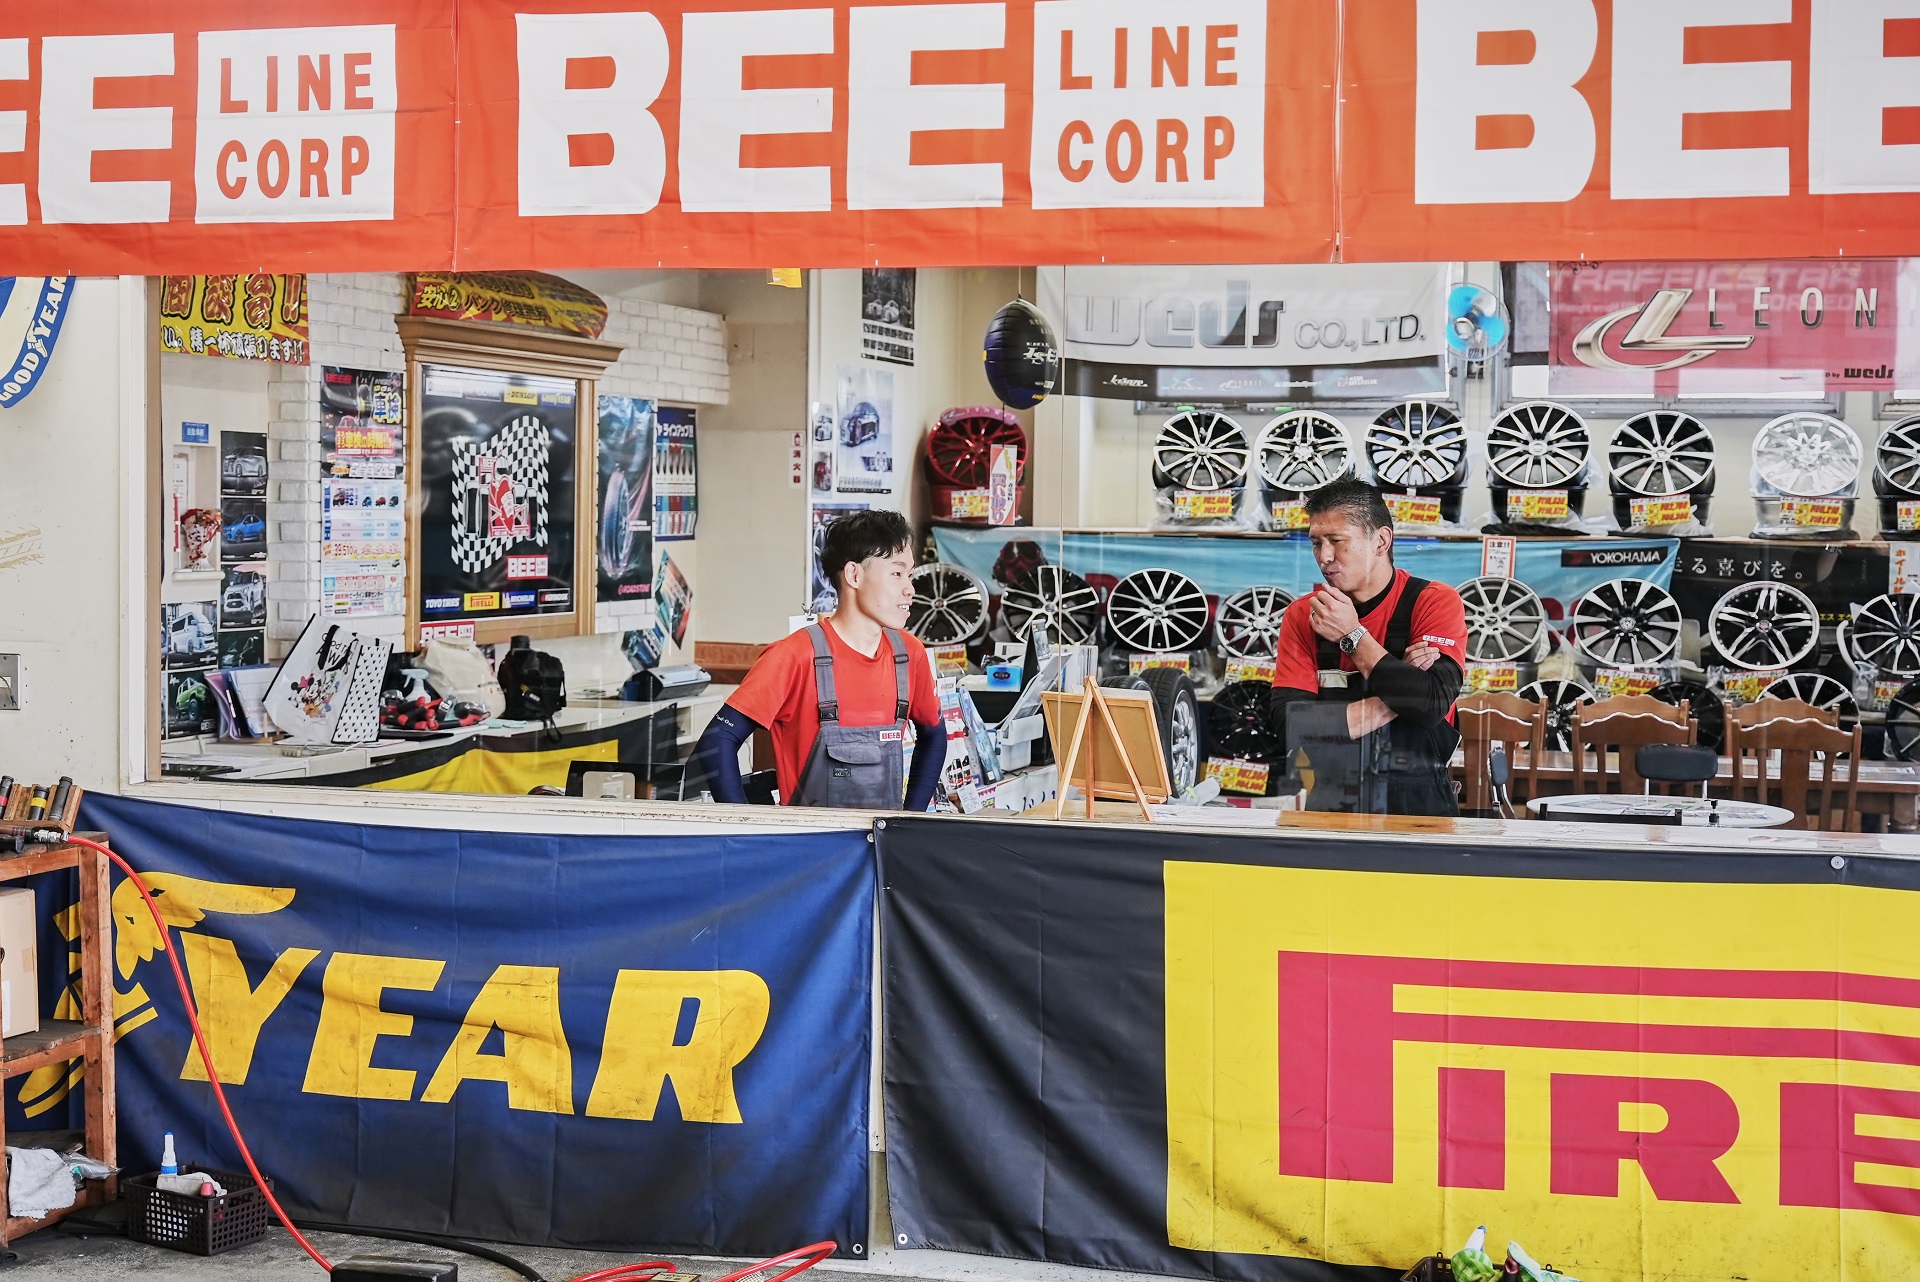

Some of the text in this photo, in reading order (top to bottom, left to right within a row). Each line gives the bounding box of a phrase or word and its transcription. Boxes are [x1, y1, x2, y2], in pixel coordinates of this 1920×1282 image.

[219, 52, 374, 114] LINE
[1060, 24, 1238, 90] LINE
[0, 33, 174, 225] E
[515, 2, 1006, 216] BEE
[216, 135, 370, 199] CORP
[1057, 115, 1236, 183] CORP
[1066, 280, 1286, 348] weds
[1273, 508, 1285, 516] 17
[507, 557, 536, 578] BEE
[1590, 550, 1661, 564] YOKOHAMA
[470, 595, 493, 608] PIRELLI
[1597, 675, 1610, 684] 17
[1726, 679, 1739, 689] 17
[1208, 764, 1221, 773] 15
[179, 931, 771, 1125] YEAR
